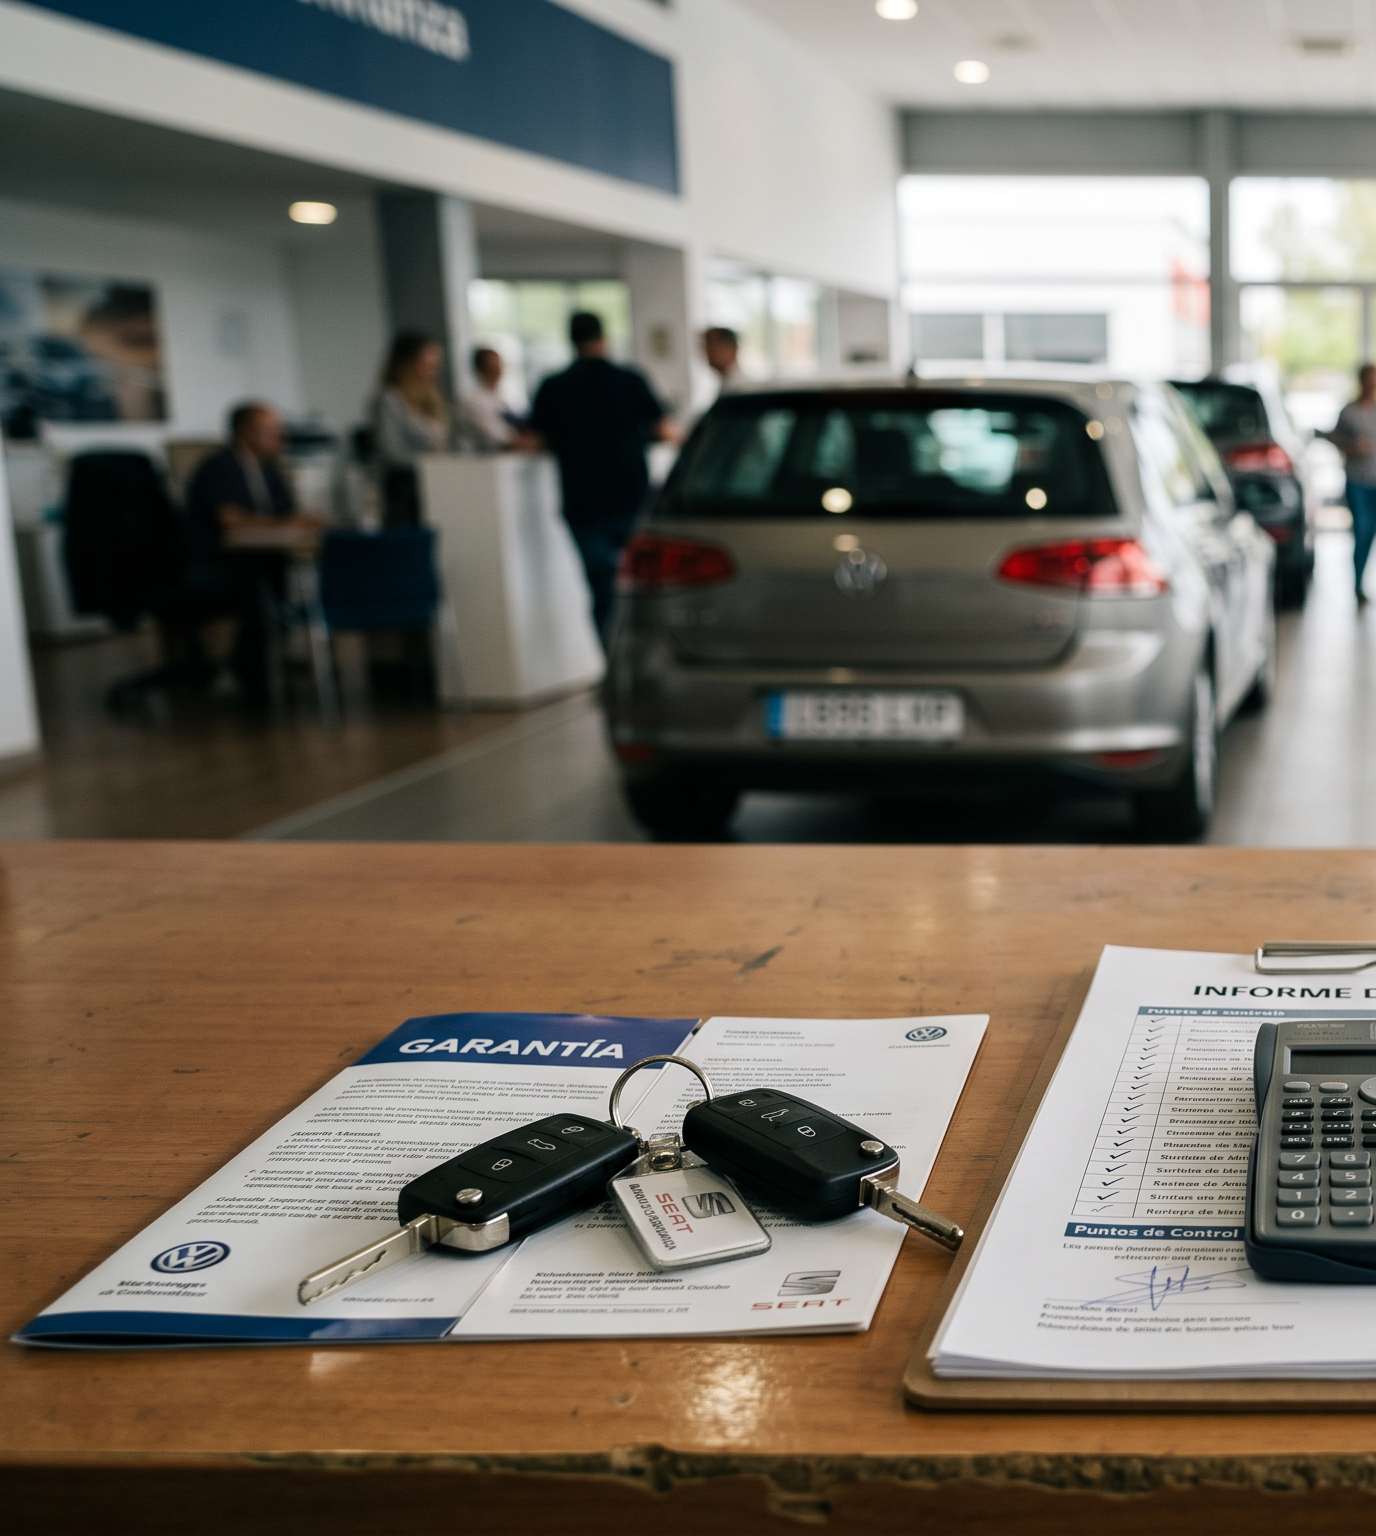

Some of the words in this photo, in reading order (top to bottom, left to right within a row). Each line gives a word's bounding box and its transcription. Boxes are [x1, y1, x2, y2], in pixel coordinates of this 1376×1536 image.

[1193, 985, 1352, 999] INFORME
[399, 1037, 624, 1060] GARANTÍA
[1294, 1154, 1306, 1163] 7
[1344, 1154, 1356, 1162] 8
[1292, 1172, 1305, 1180] 4
[1345, 1172, 1357, 1180] 5
[1345, 1190, 1357, 1199] 2
[655, 1192, 694, 1234] SEAT
[1291, 1209, 1305, 1220] 0
[1074, 1224, 1138, 1237] Puntos
[1143, 1226, 1165, 1237] de
[1170, 1228, 1239, 1239] Control
[750, 1297, 852, 1311] SEAT
